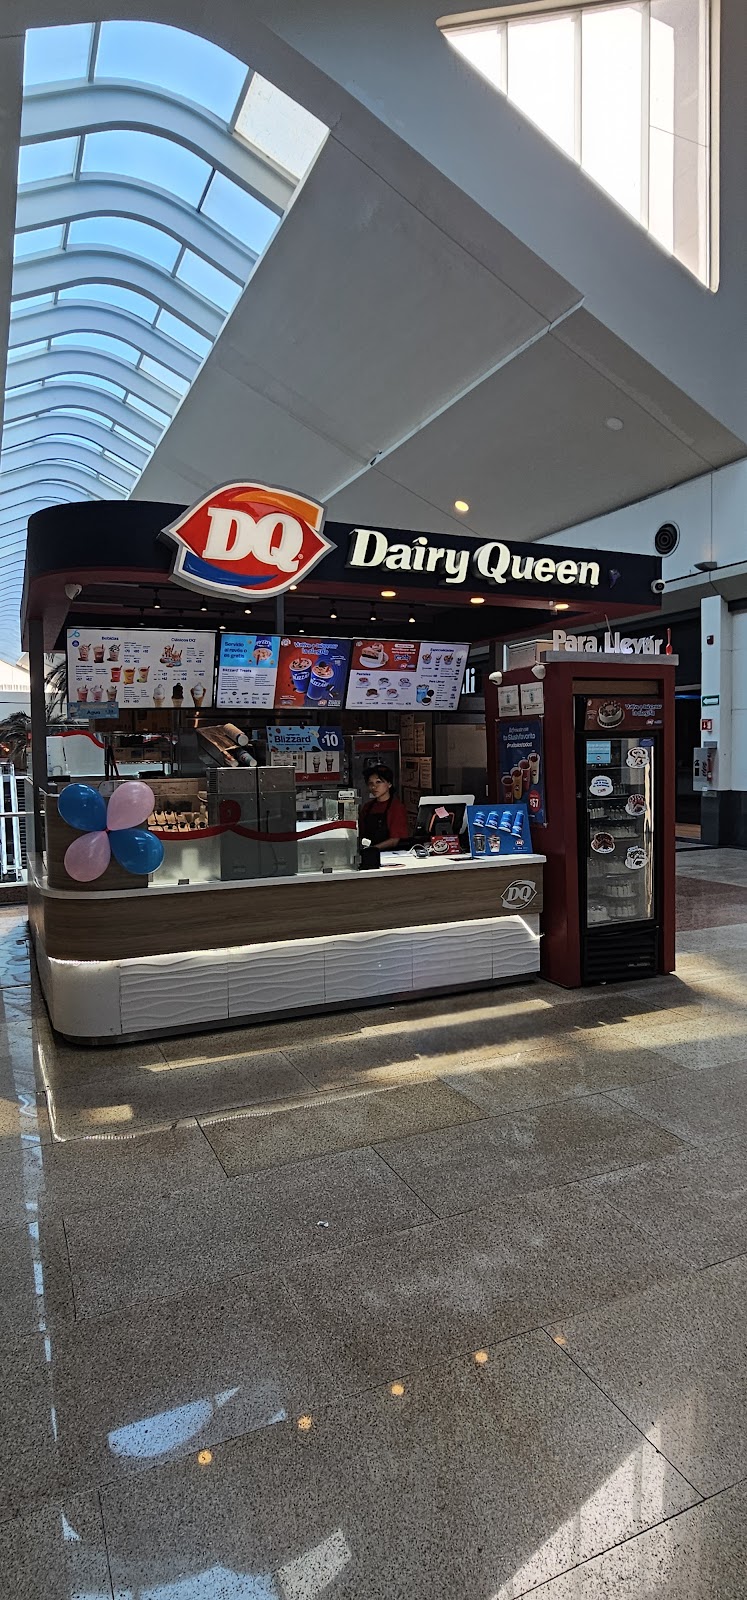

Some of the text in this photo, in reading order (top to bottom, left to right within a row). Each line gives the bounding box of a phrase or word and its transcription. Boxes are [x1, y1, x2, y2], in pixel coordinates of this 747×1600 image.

[202, 507, 304, 573] DQ
[349, 529, 600, 587] Dairy Queen
[552, 629, 598, 652] Para
[274, 735, 311, 743] Blizzard
[321, 733, 340, 748] $10
[529, 798, 540, 808] $57
[506, 886, 532, 903] DQ
